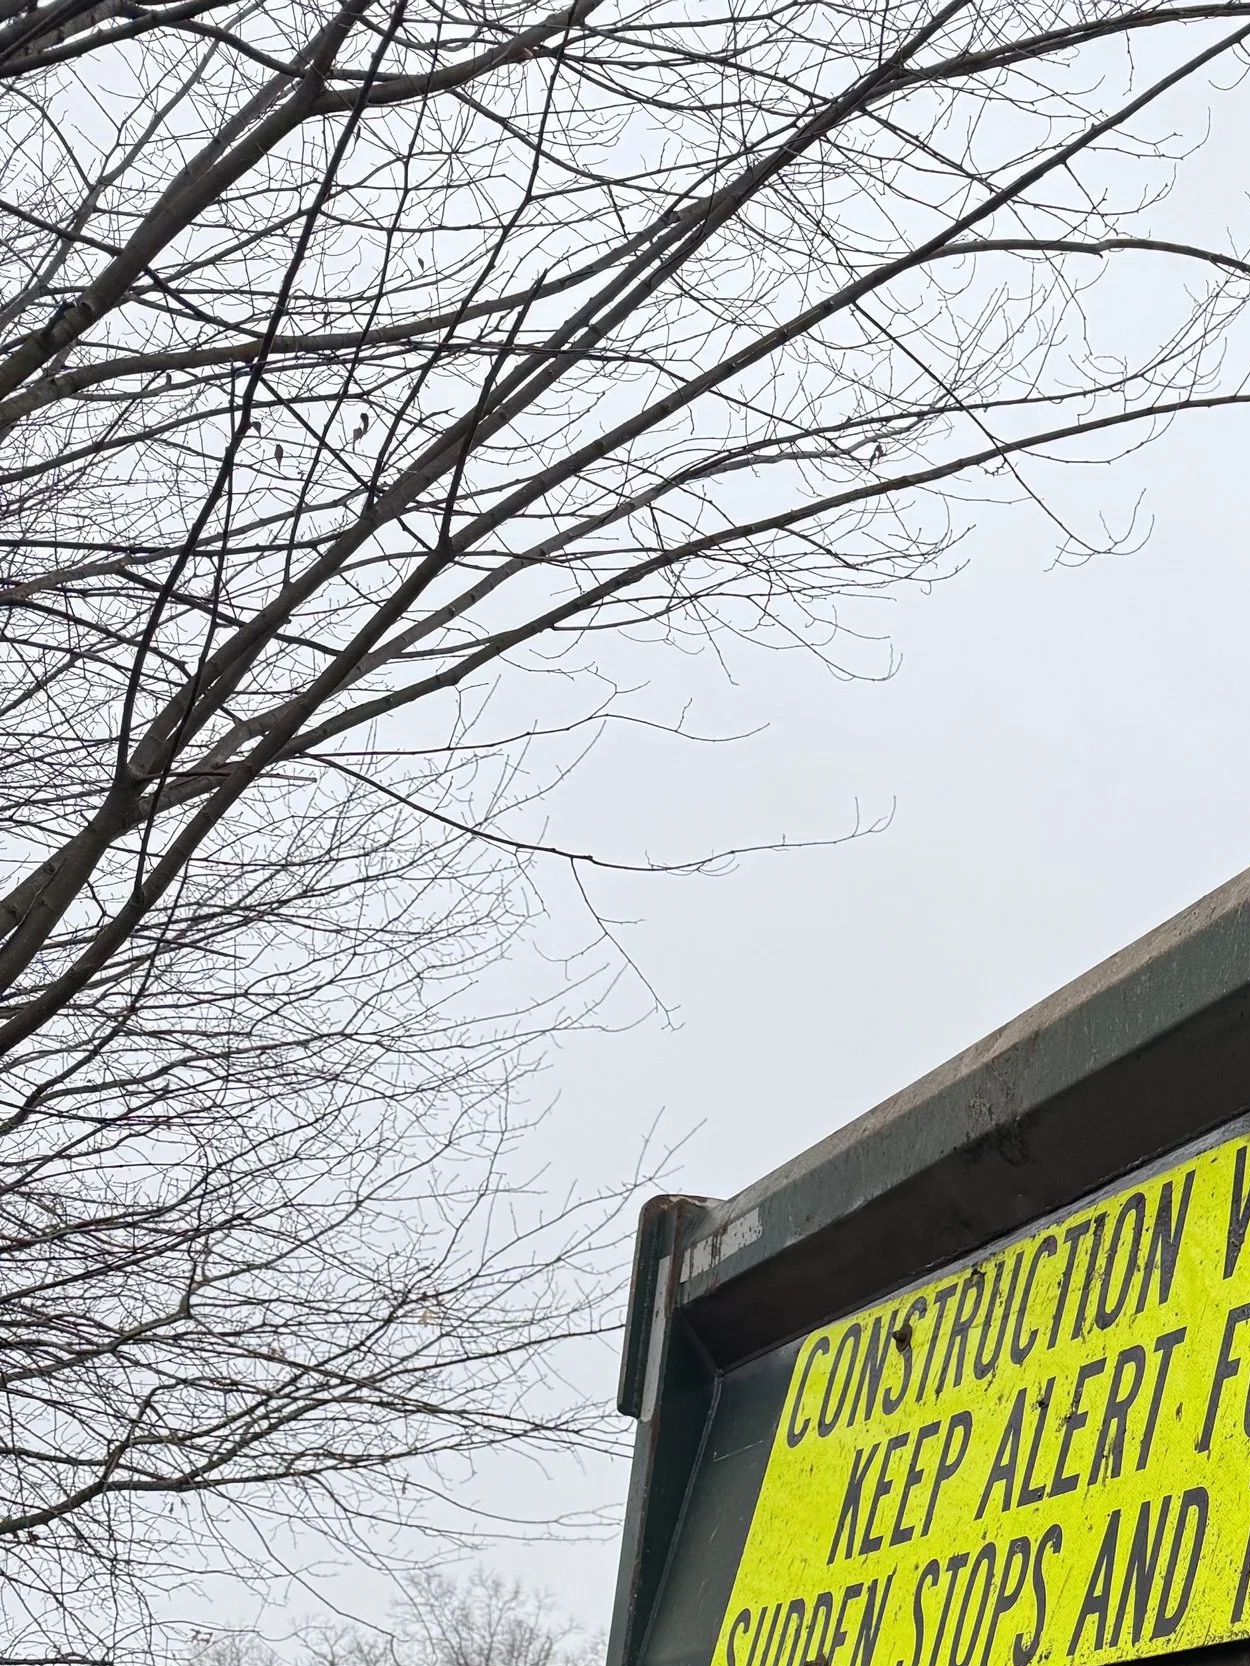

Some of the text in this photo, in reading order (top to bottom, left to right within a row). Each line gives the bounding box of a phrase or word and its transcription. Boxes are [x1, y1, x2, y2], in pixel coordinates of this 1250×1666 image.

[786, 1171, 1194, 1447] CONSTRUCTION
[827, 1411, 972, 1566] KEEP
[974, 1329, 1186, 1520] ALERT
[1067, 1487, 1208, 1657] AND
